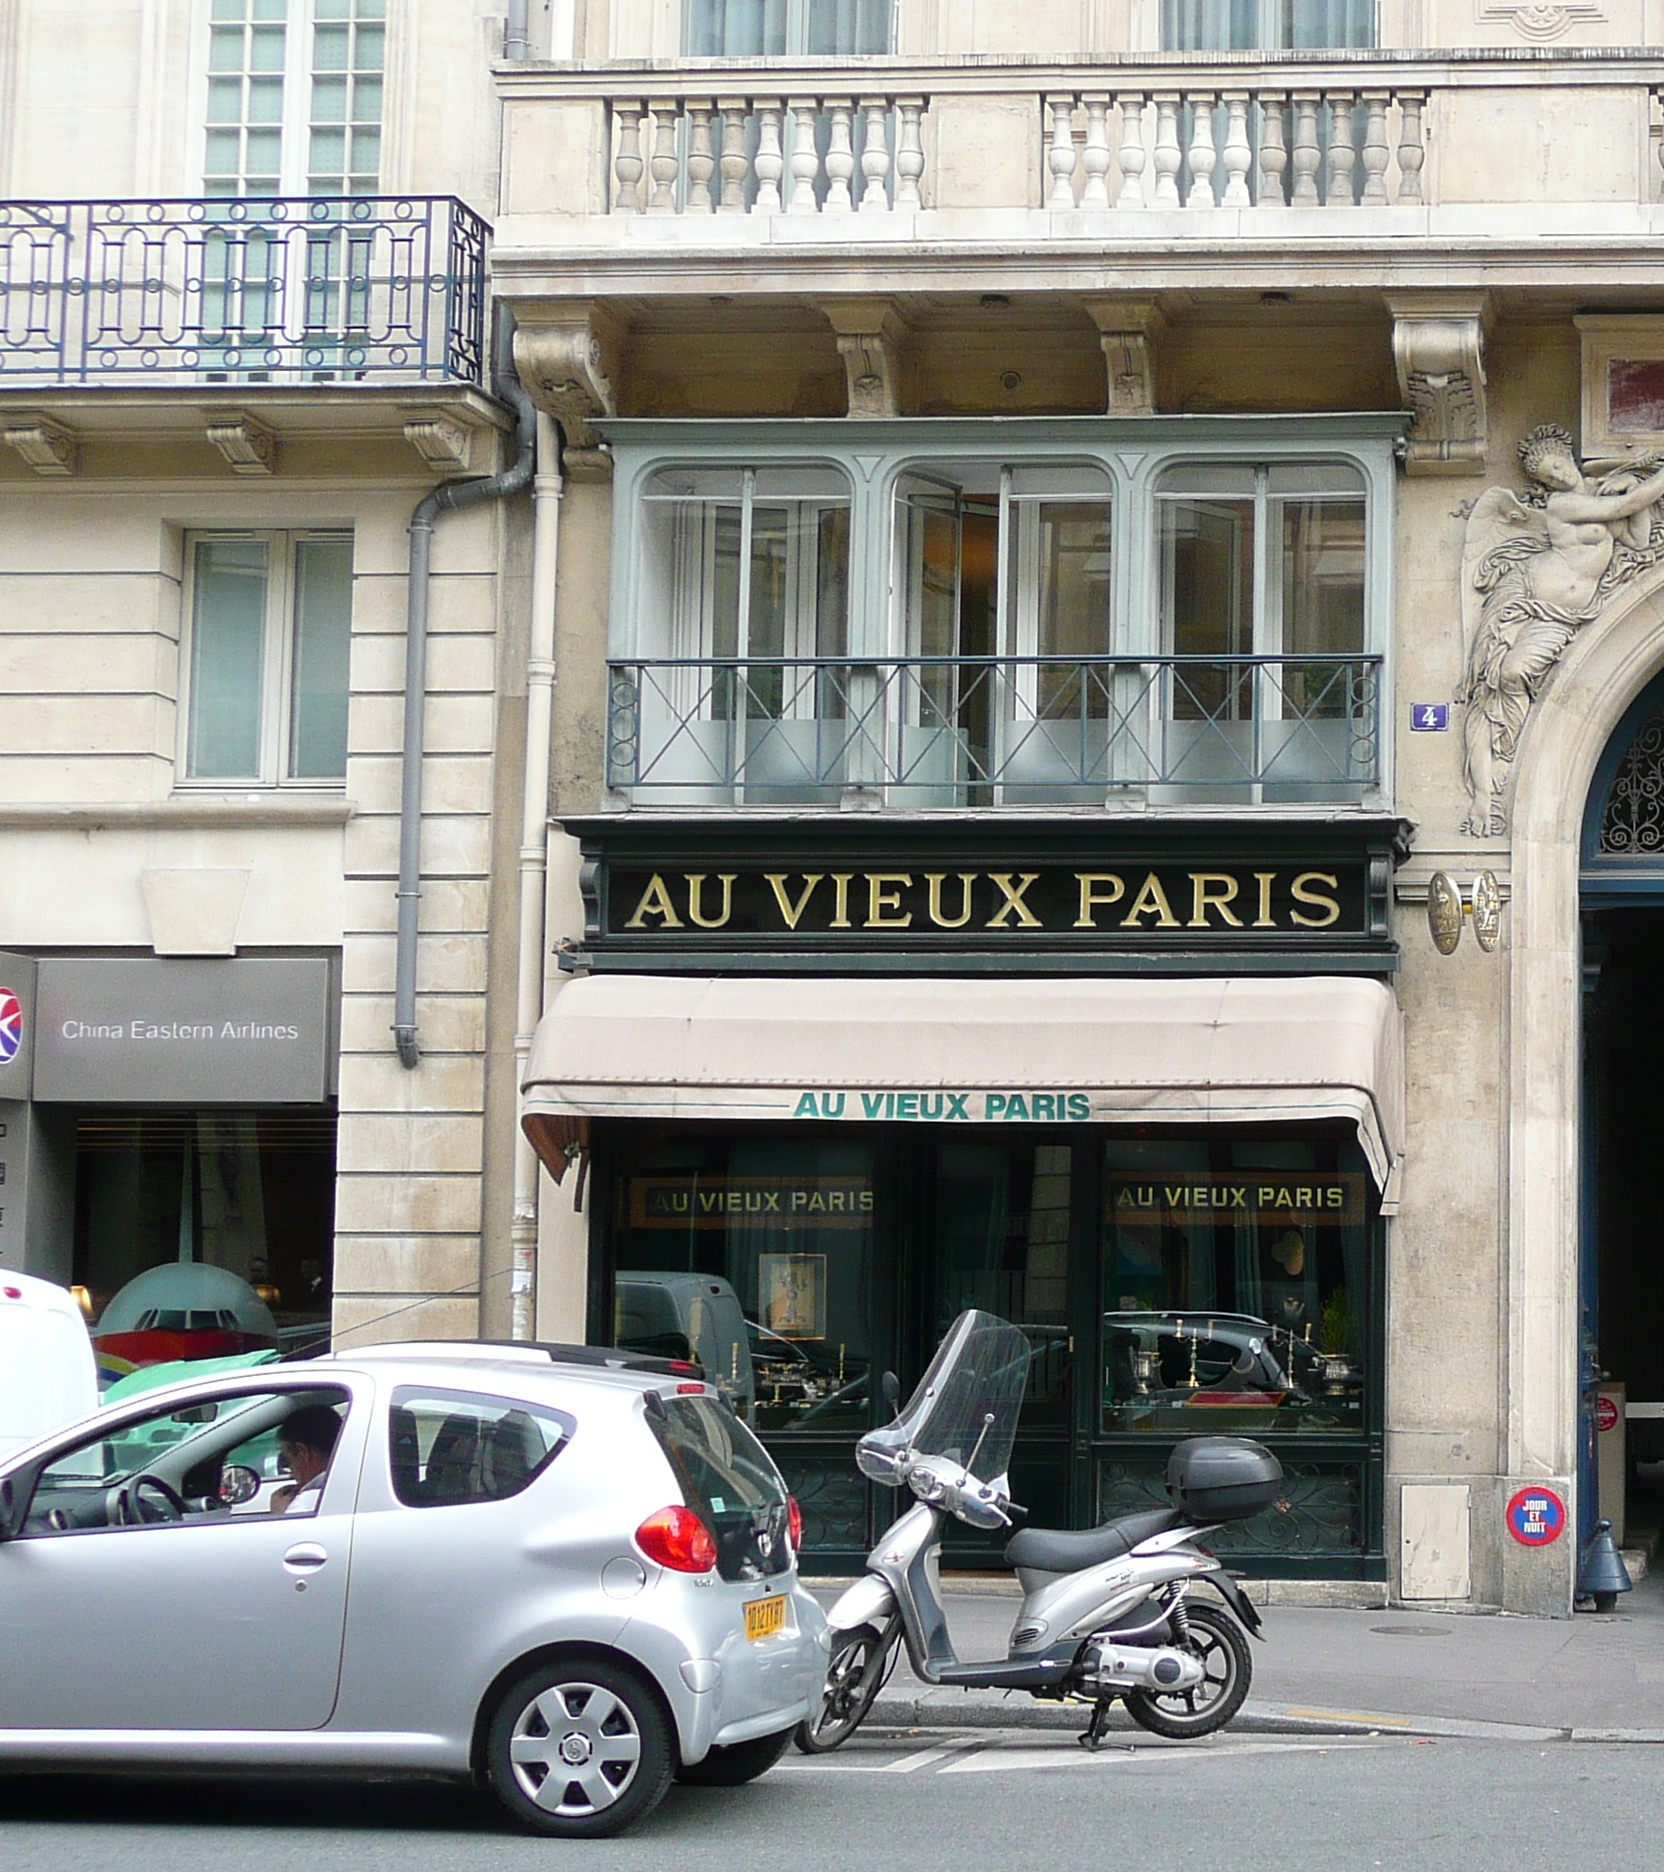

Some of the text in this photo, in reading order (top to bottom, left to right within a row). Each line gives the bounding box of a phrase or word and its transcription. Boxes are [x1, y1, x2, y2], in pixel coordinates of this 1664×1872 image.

[1421, 705, 1438, 727] 4
[624, 872, 1341, 930] AU VIEUX PARIS
[62, 1020, 299, 1040] China Eastern Airlines
[793, 1092, 1091, 1121] AU VIEUX PARIS
[653, 1191, 874, 1212] AU VIEUX PARIS
[1116, 1187, 1344, 1208] AU VIEUX PARIS
[1522, 1499, 1548, 1511] JOUR
[1529, 1511, 1541, 1522] ET
[1523, 1522, 1546, 1533] NUIT
